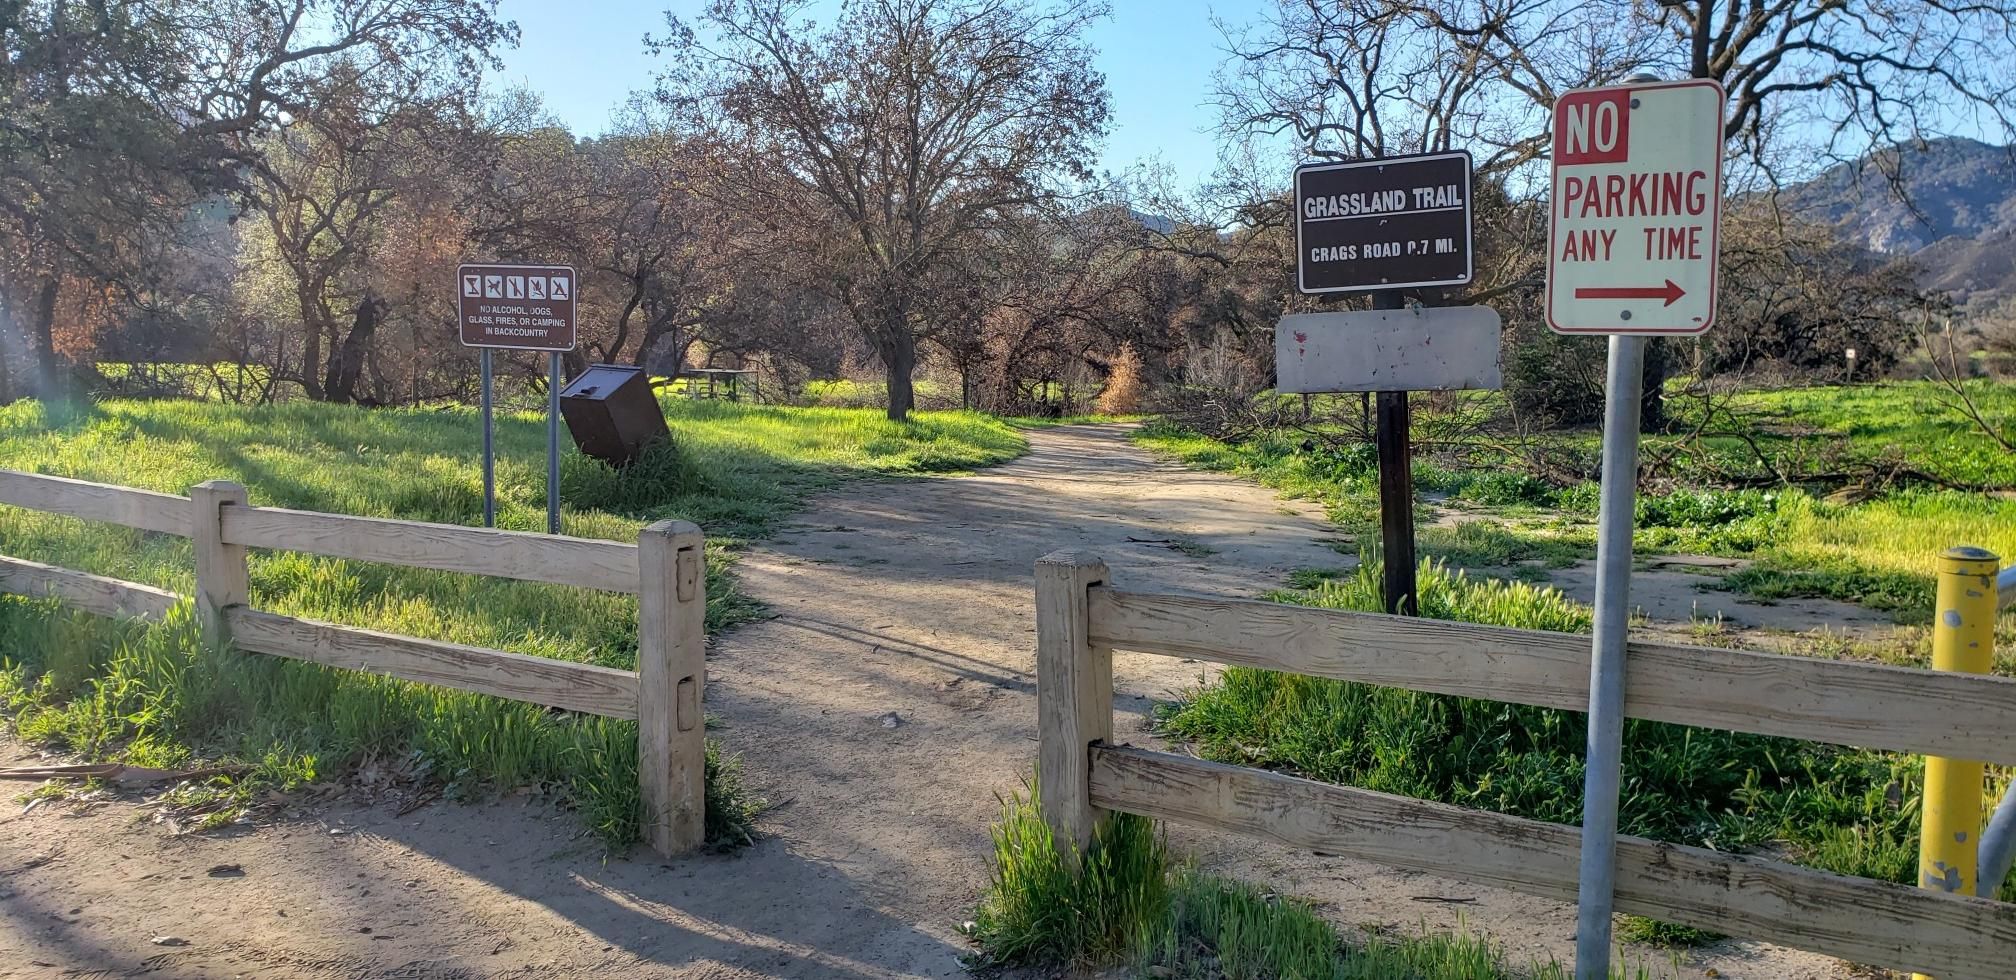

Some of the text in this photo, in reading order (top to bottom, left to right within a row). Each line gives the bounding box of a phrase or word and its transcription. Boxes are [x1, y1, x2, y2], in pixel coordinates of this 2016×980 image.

[1566, 100, 1619, 155] NO
[1304, 184, 1463, 219] GRASSLAND TRAIL
[1563, 170, 1707, 219] PARKING
[1311, 245, 1357, 263] CRAGS
[1363, 241, 1401, 259] ROAD
[1435, 237, 1458, 254] MI.
[1561, 226, 1703, 263] ANY TIME
[468, 315, 566, 328] GLASS, FIRES, OR CAMPING
[480, 305, 491, 313] NO
[492, 305, 528, 315] ALCOHOL,
[485, 327, 549, 337] IN BACKCOUNTRY
